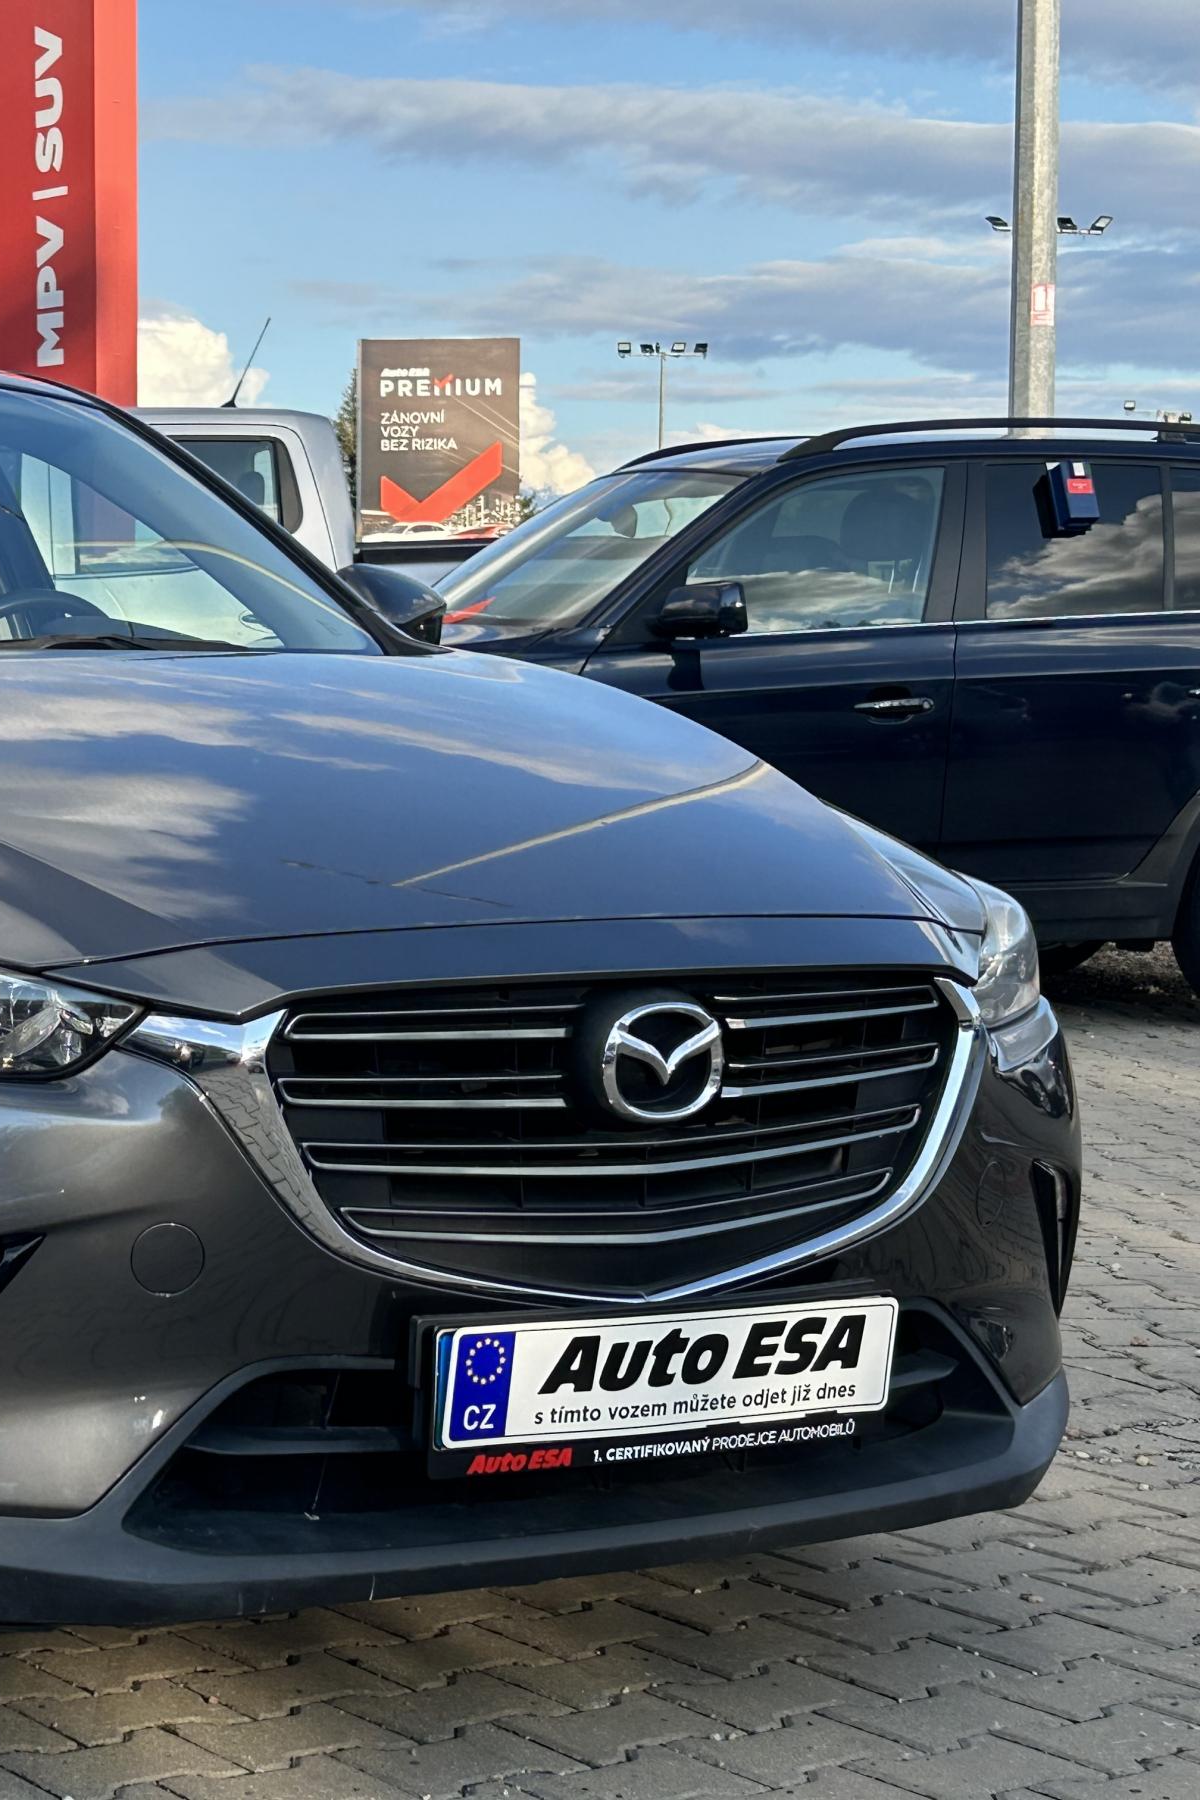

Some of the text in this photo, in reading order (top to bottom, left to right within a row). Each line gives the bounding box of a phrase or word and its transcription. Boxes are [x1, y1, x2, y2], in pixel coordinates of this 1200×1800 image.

[34, 25, 64, 173] SUV
[36, 215, 65, 368] MPV
[380, 376, 503, 398] PREMIUM
[380, 409, 445, 425] ZÁNOVNÍ
[380, 426, 420, 438] VOZY
[380, 438, 458, 451] BEZ RIZIKA
[537, 1314, 867, 1395] Auto ESA
[462, 1404, 495, 1431] CZ
[534, 1383, 856, 1425] s tímto vozem můžete odjet již dnes
[605, 1436, 711, 1462] CERTIFIKOVANÝ
[711, 1429, 777, 1450] PRODEJCE
[778, 1418, 856, 1442] AUTOMOBILŮ
[466, 1447, 572, 1475] Auto ESA
